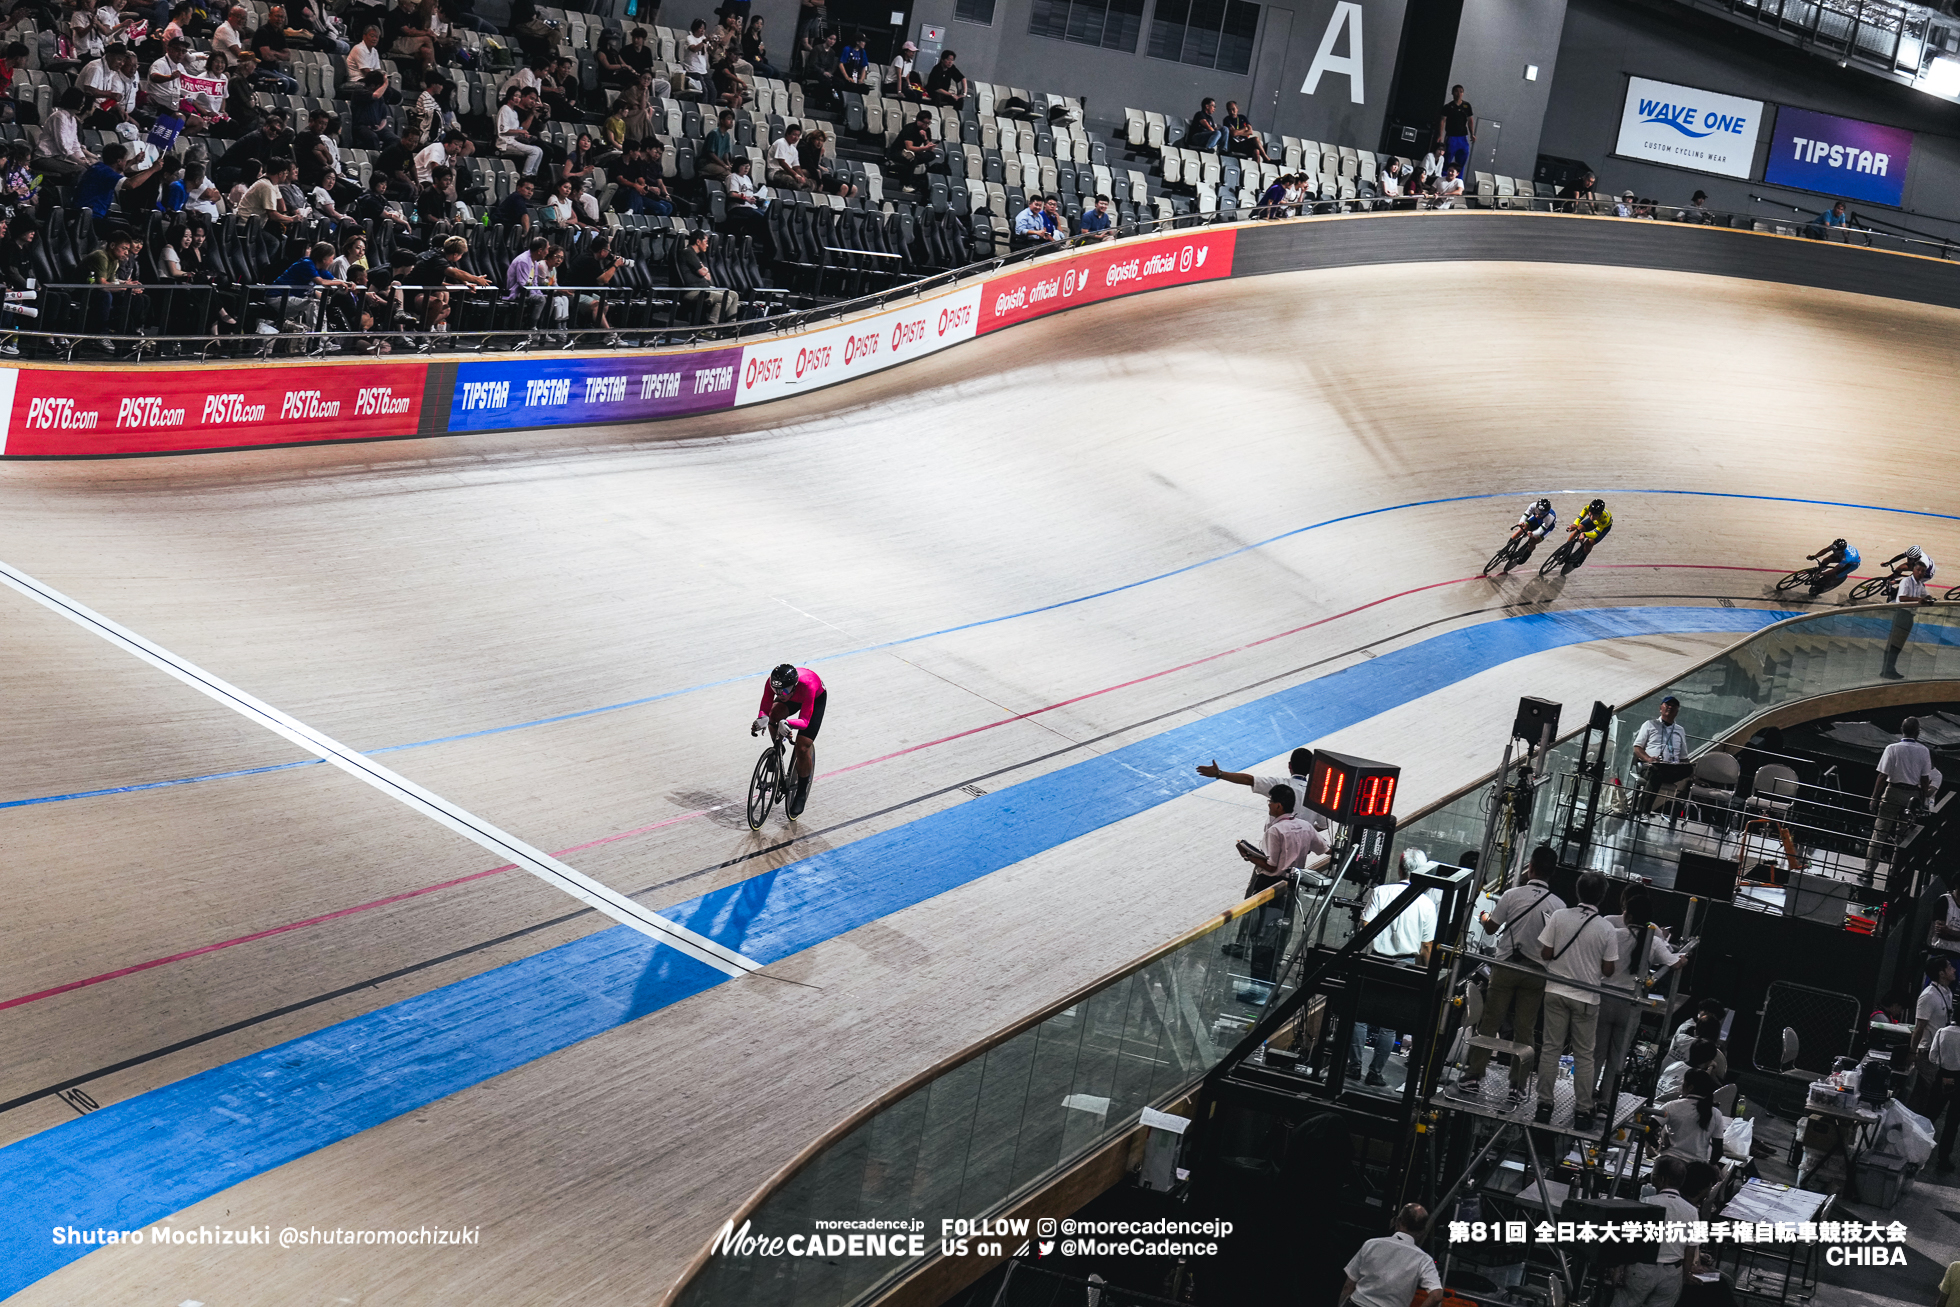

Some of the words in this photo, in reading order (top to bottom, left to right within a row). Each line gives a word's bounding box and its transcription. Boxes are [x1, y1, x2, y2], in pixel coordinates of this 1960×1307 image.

[1300, 1, 1364, 104] A
[1638, 98, 1697, 125] WAVE
[1703, 112, 1746, 135] ONE
[1644, 141, 1672, 153] CUSTOM
[1675, 146, 1704, 159] CYCLING
[1708, 153, 1727, 163] WEAR
[1793, 136, 1889, 177] TIPSTAR
[1106, 251, 1177, 286] @pist6_official
[995, 276, 1061, 316] @pist6_official
[900, 319, 926, 345] PIST6
[949, 305, 972, 331] PIST6
[805, 345, 832, 372] PIST6
[853, 333, 880, 359] PIST6
[693, 366, 734, 394] TIPSTAR
[756, 357, 783, 383] PIST6
[461, 380, 510, 410] TIPSTAR
[525, 378, 571, 407] TIPSTAR
[584, 376, 627, 403] TIPSTAR
[640, 372, 681, 400] TIPSTAR
[26, 397, 98, 429] PIST6.com
[116, 396, 185, 428] PIST6.com
[201, 393, 266, 424] PIST6.com
[280, 390, 341, 419] PIST6.com
[354, 387, 410, 415] PIST6.com
[1321, 767, 1344, 811] 11
[66, 1088, 100, 1111] 10
